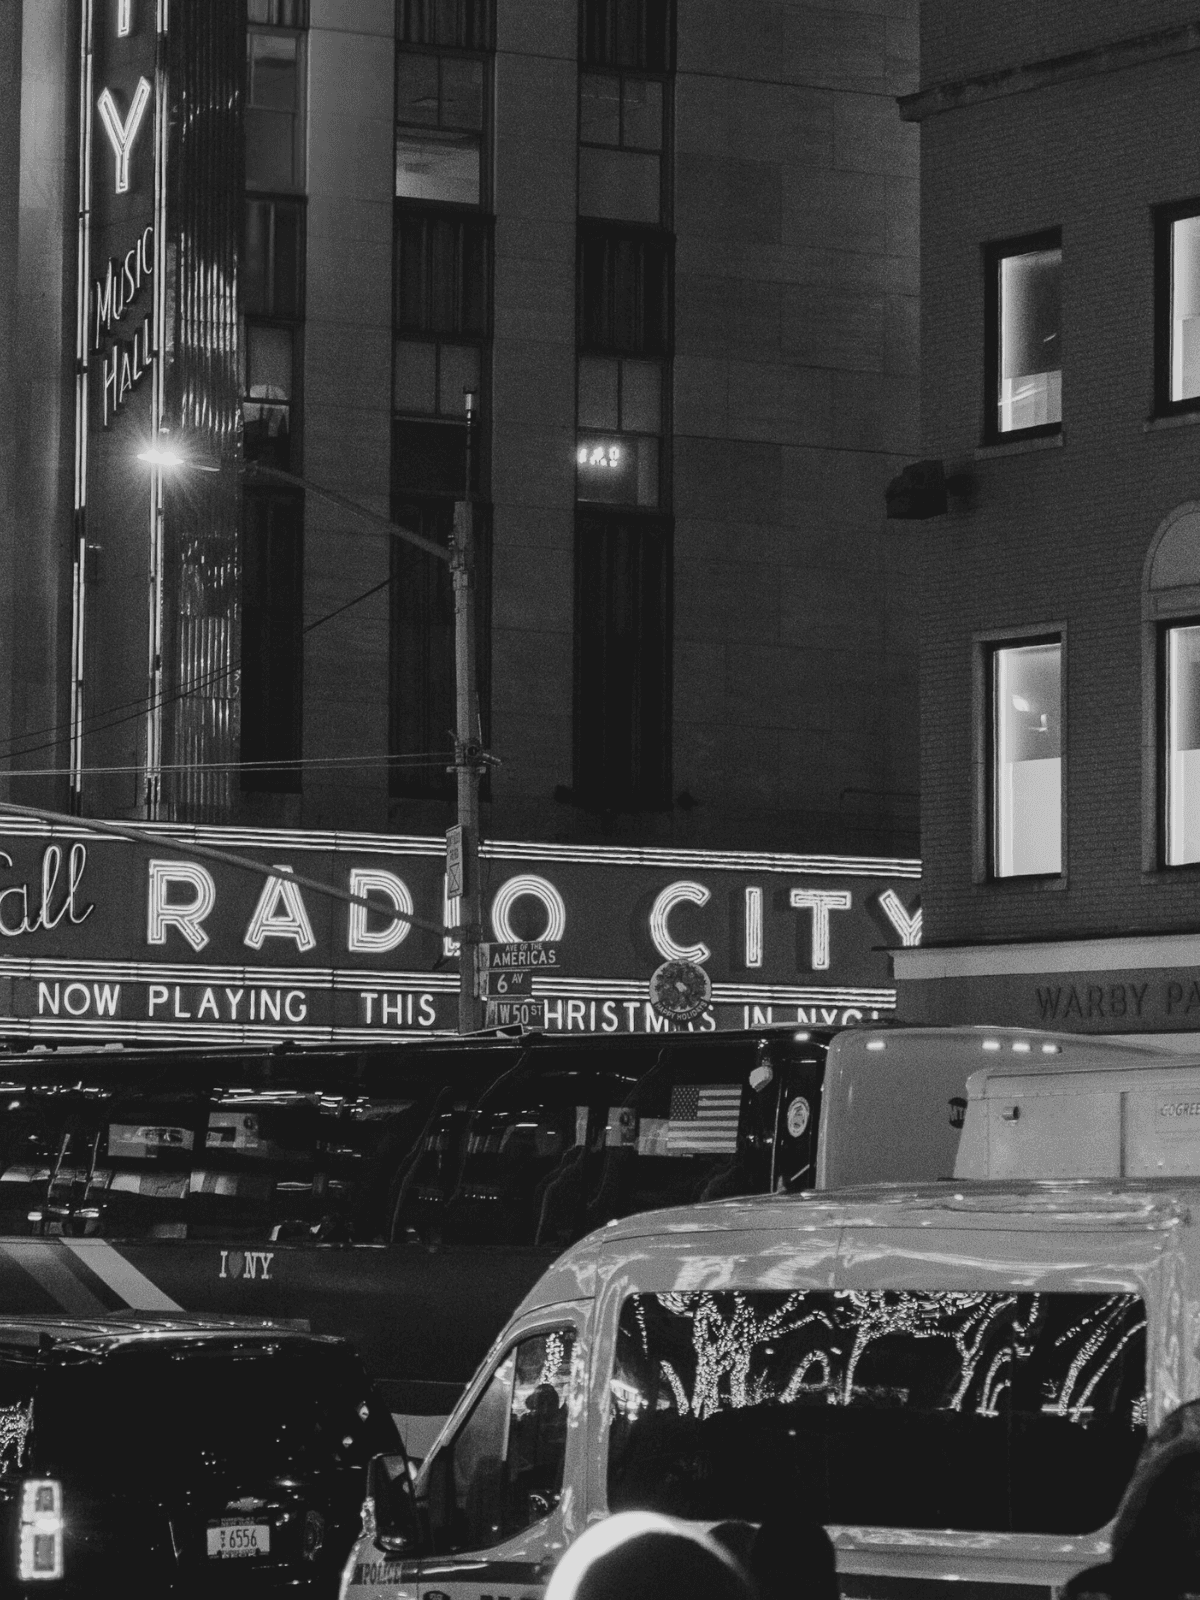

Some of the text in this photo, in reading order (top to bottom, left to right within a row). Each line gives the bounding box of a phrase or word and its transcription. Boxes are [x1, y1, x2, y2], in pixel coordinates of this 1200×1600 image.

[96, 226, 153, 349] MUSIC
[103, 317, 152, 427] HALL
[505, 942, 543, 951] AVE OF THE
[493, 950, 556, 967] AMERICAS
[497, 973, 523, 993] 6 AV
[38, 981, 120, 1017] NOW
[148, 985, 308, 1022] PLAYING
[360, 992, 436, 1026] THIS
[543, 999, 716, 1033] HRISTMS
[744, 1004, 773, 1030] IN
[655, 1001, 708, 1020] HAPPY HOLIDAYS
[1035, 982, 1149, 1020] WARBY
[500, 1004, 542, 1024] W 50 ST
[243, 1251, 274, 1279] NY
[229, 1529, 257, 1548] 6556
